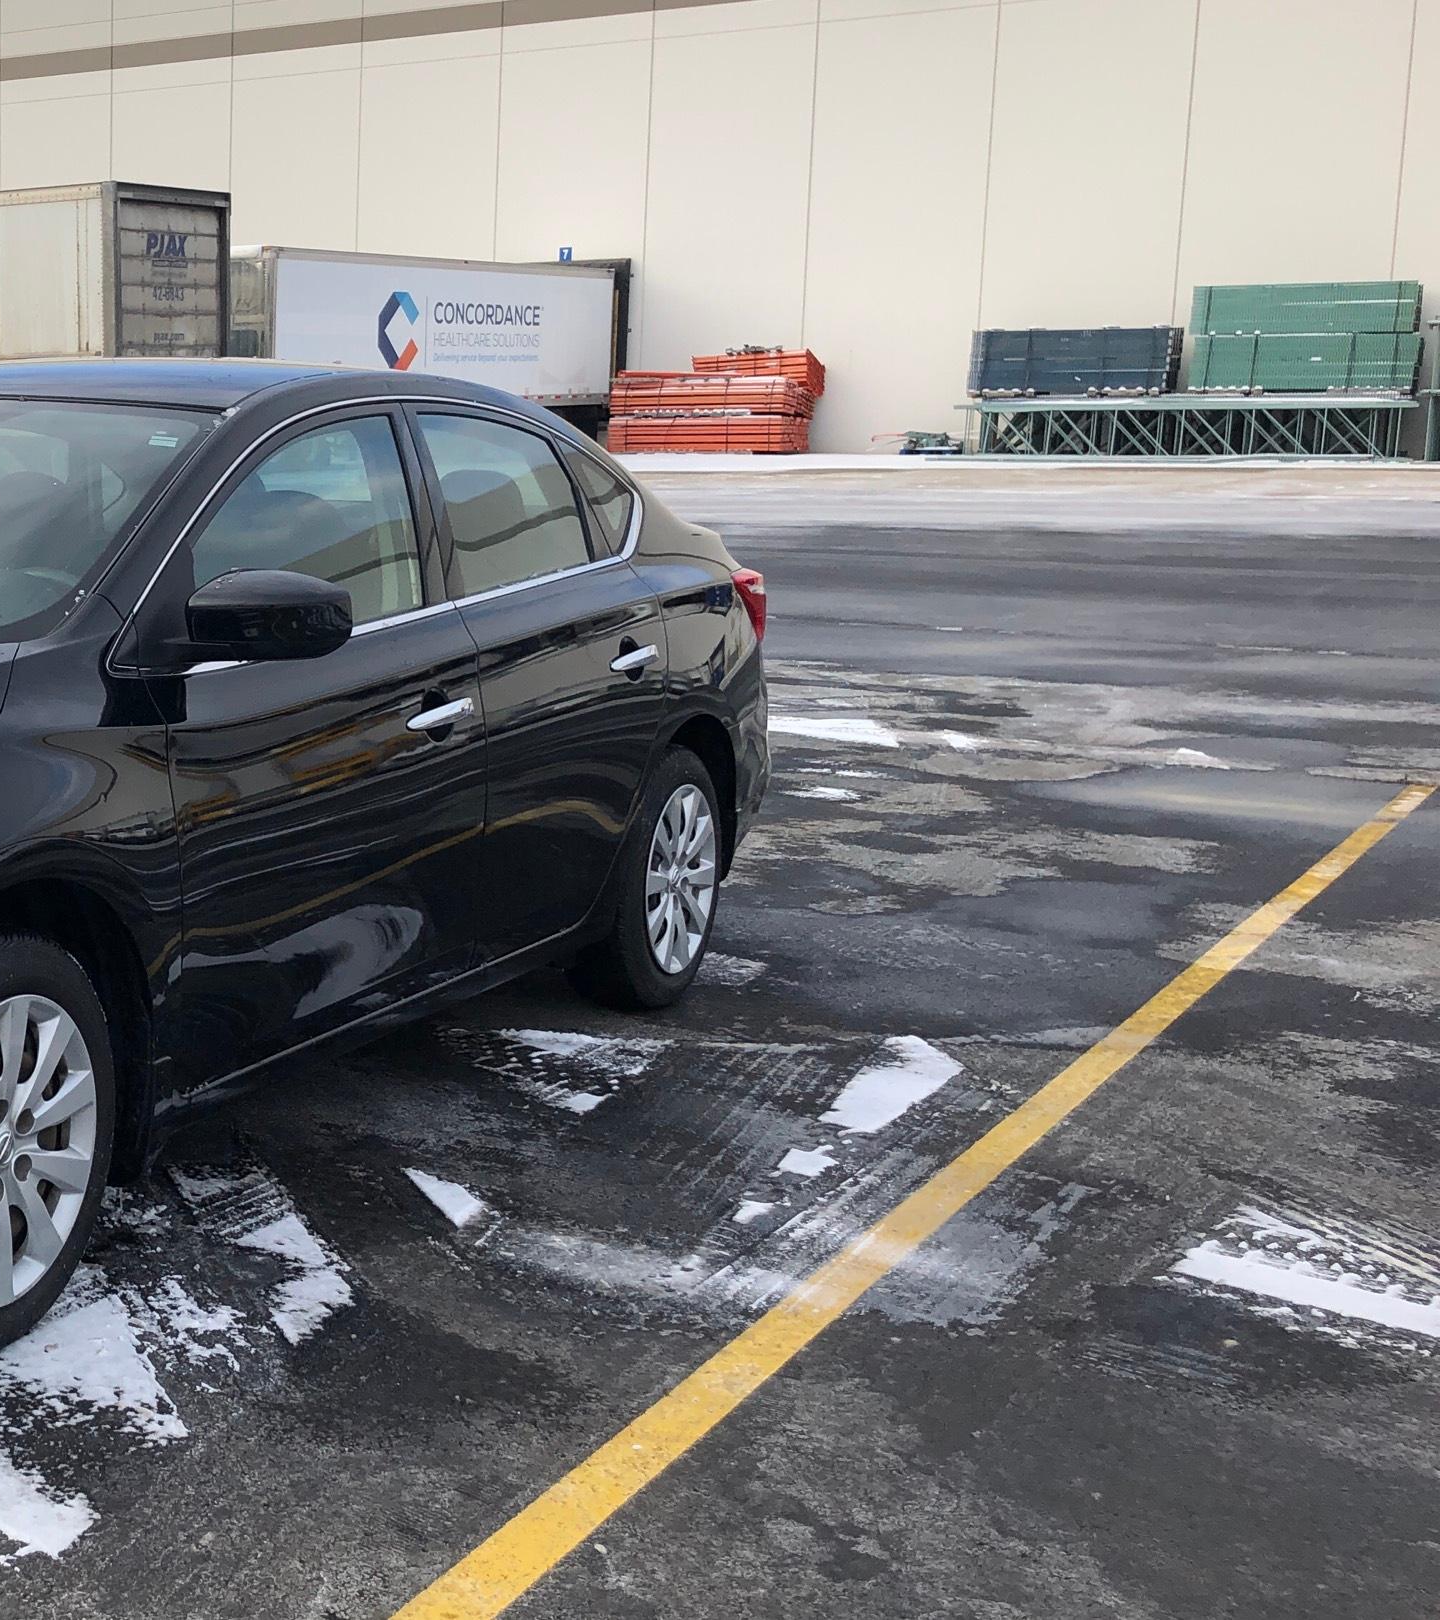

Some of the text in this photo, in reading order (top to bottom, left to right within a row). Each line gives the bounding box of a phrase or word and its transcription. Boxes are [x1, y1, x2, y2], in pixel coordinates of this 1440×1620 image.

[146, 232, 188, 258] PJAX
[562, 249, 569, 260] 7
[433, 301, 540, 326] CONCORDANCE
[433, 332, 540, 348] HEALTHCARE SOLUTIONS
